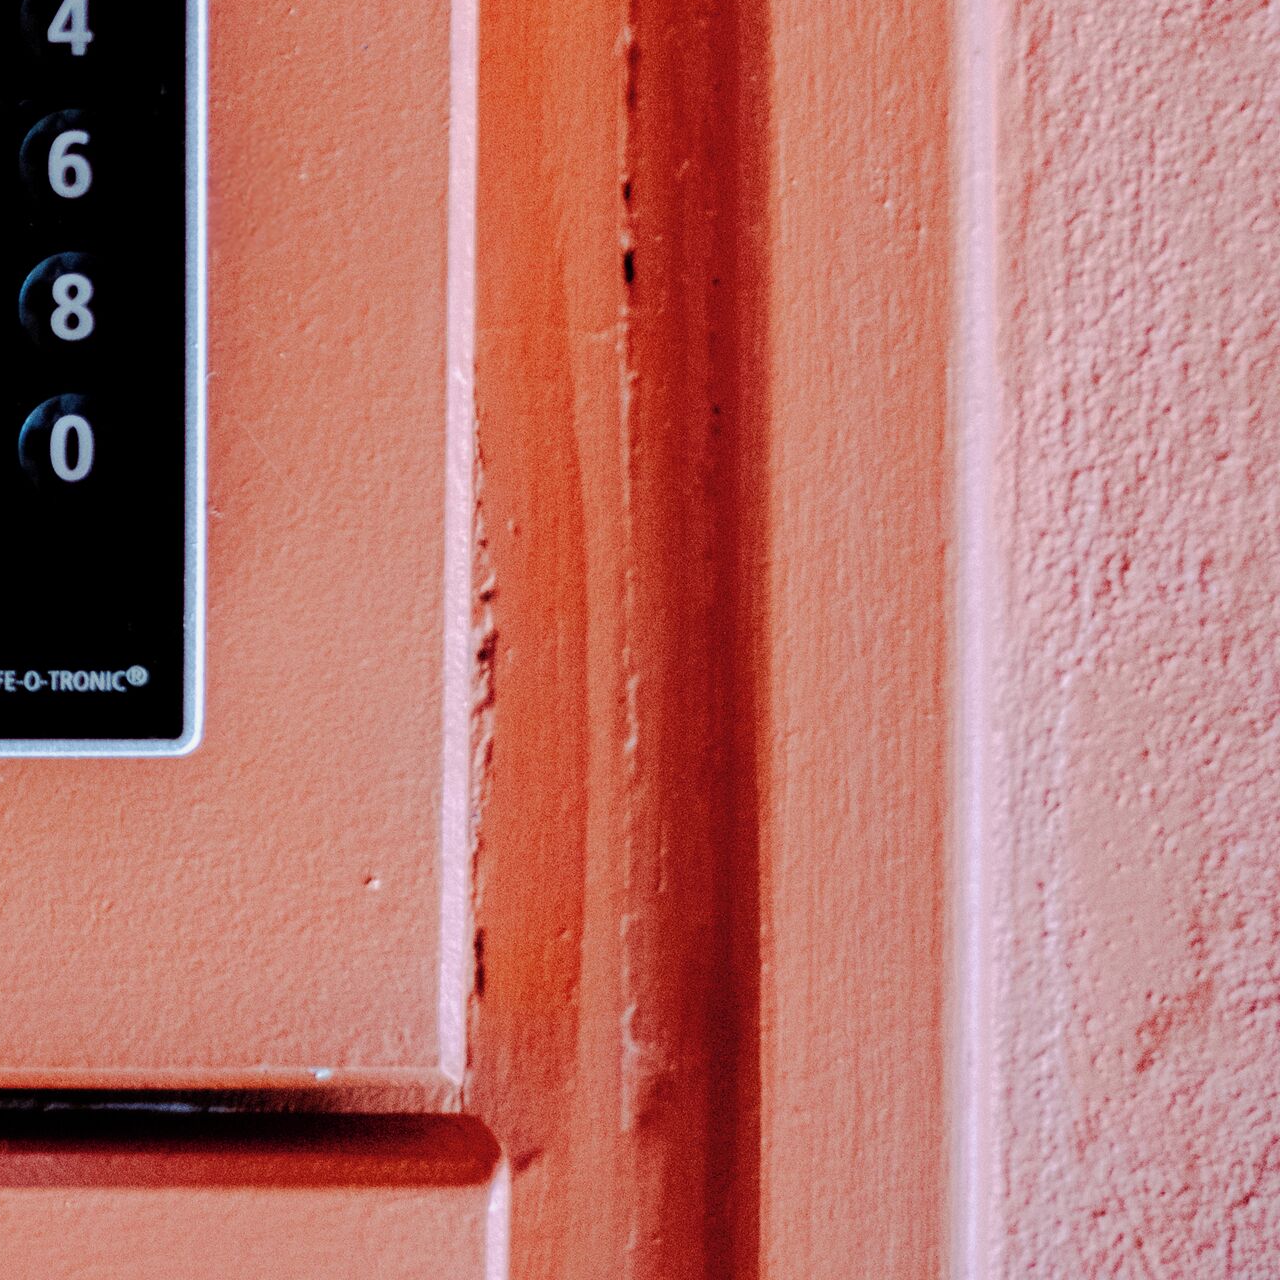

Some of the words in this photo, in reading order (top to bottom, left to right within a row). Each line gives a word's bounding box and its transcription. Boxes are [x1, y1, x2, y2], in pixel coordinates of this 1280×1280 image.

[49, 130, 91, 198] 6
[51, 274, 93, 340] 8
[50, 415, 93, 481] 0
